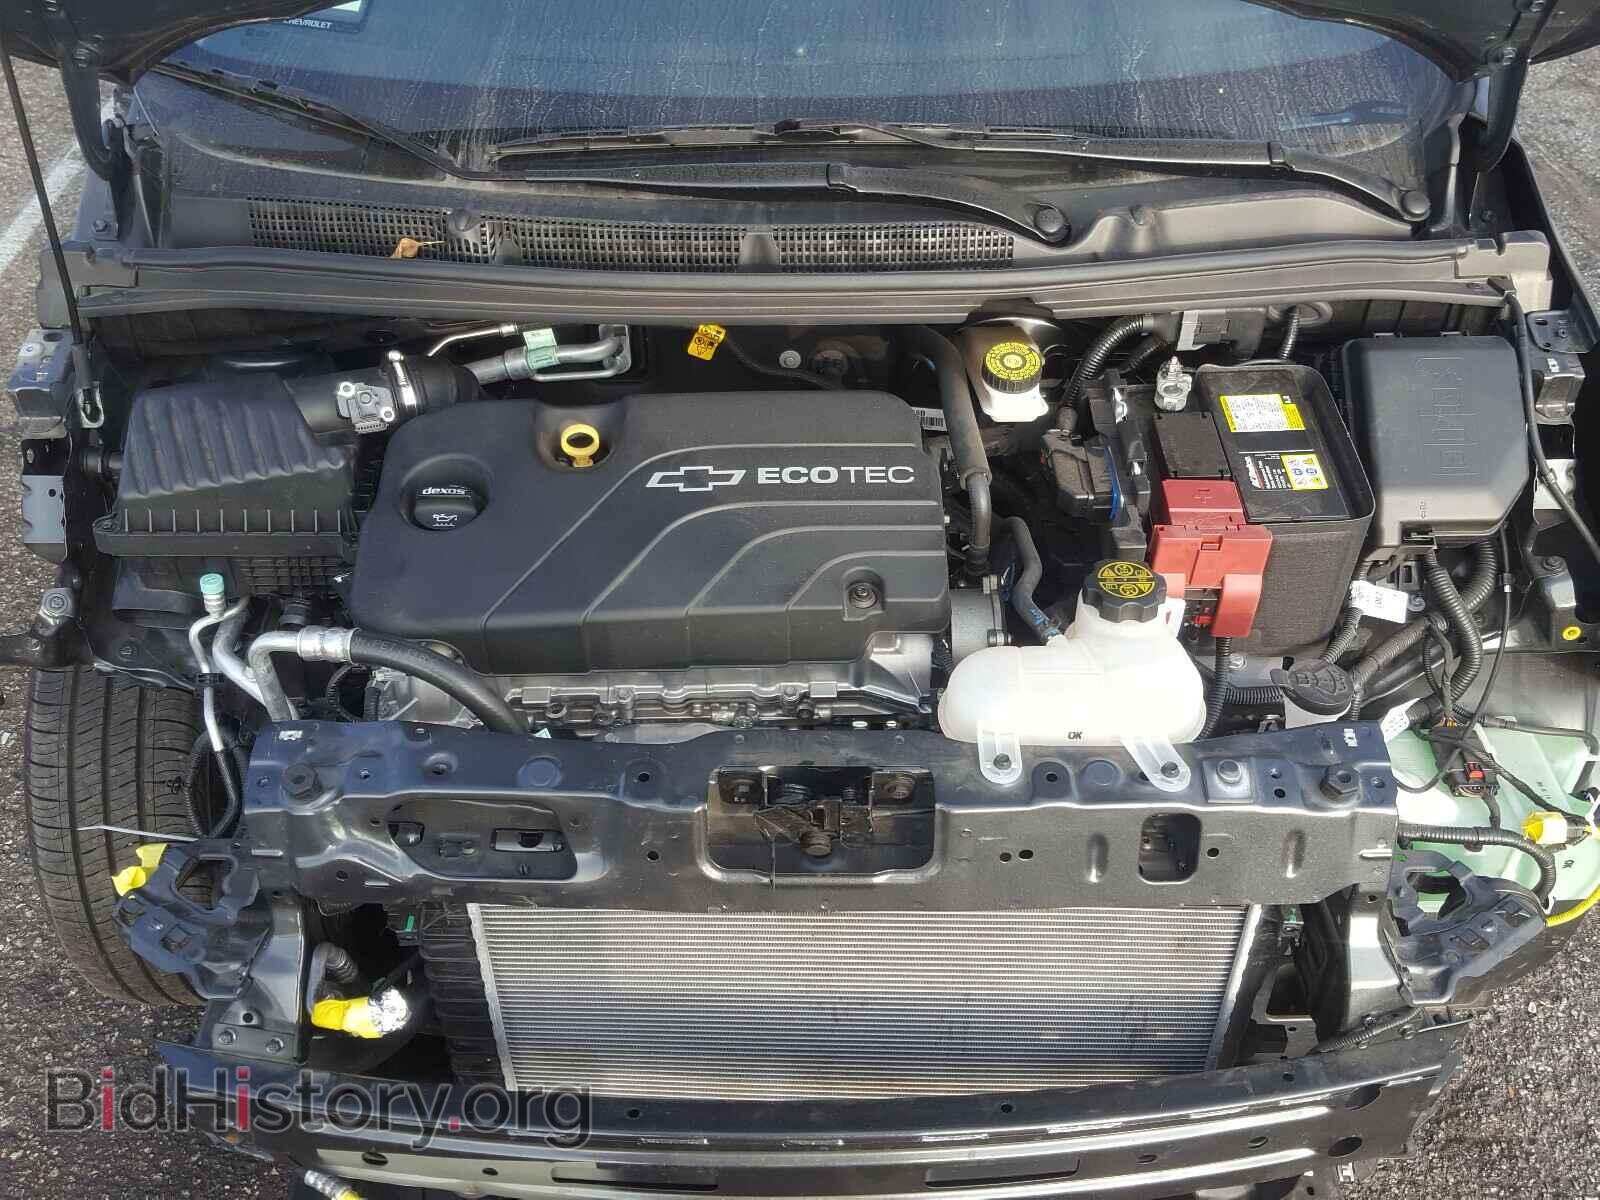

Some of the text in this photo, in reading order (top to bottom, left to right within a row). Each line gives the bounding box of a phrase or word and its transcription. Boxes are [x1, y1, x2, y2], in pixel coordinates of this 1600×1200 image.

[757, 466, 915, 484] ECOTEC
[423, 487, 465, 495] dexos
[1068, 731, 1083, 739] OK
